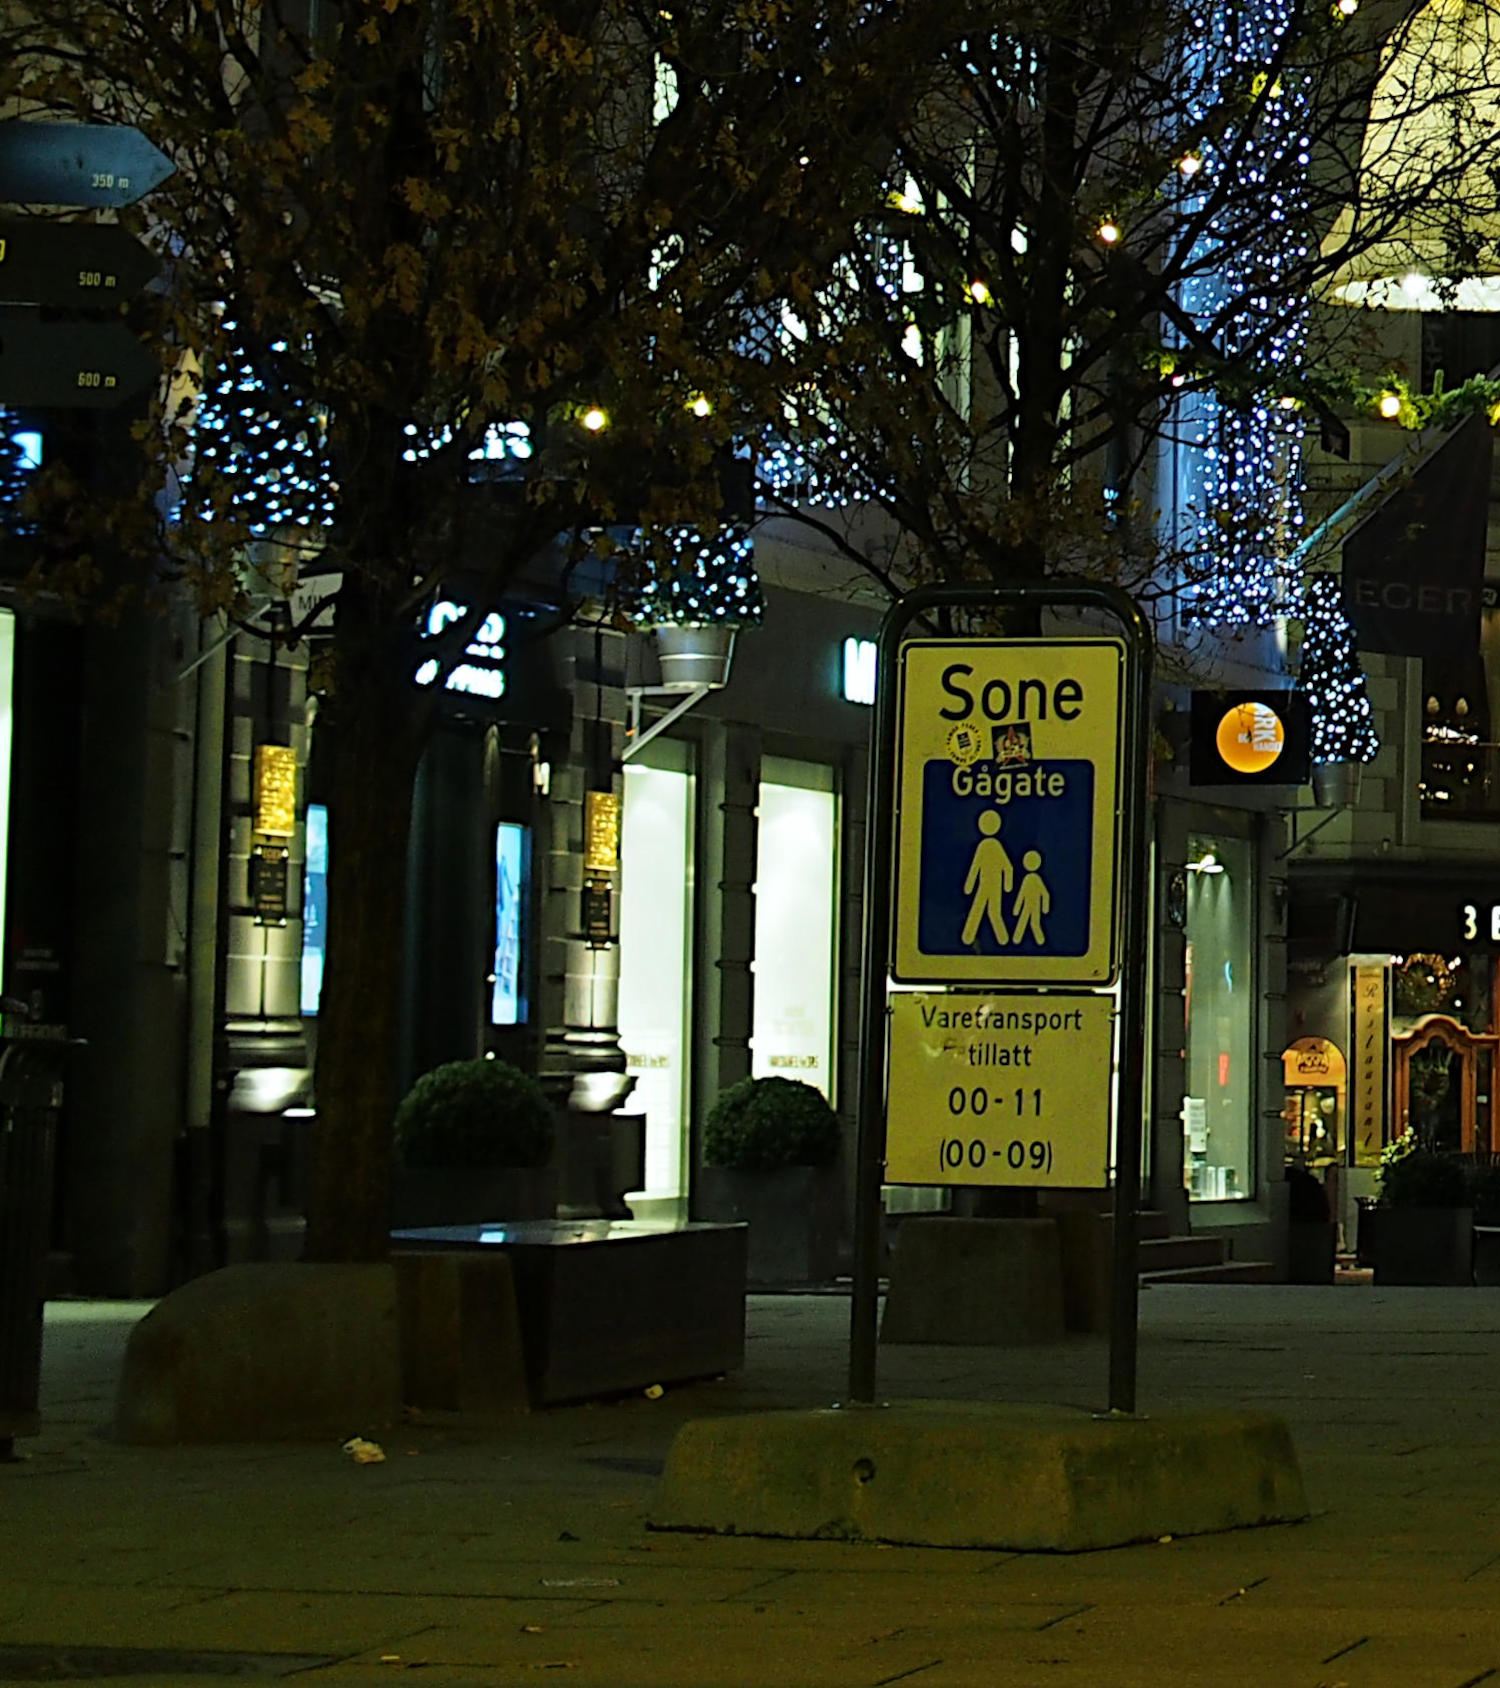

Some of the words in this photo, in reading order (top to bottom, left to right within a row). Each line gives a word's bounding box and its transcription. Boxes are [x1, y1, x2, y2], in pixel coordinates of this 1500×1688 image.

[92, 174, 113, 188] 350
[118, 176, 129, 188] m
[78, 272, 100, 287] 500
[105, 274, 116, 287] m
[104, 374, 116, 387] m
[939, 664, 1083, 721] Sone
[952, 764, 1065, 804] Gågate
[1463, 905, 1478, 941] 3
[921, 1005, 1082, 1035] Varetransport
[968, 1043, 1032, 1066] tillatt
[1363, 983, 1379, 1149] Restaurant
